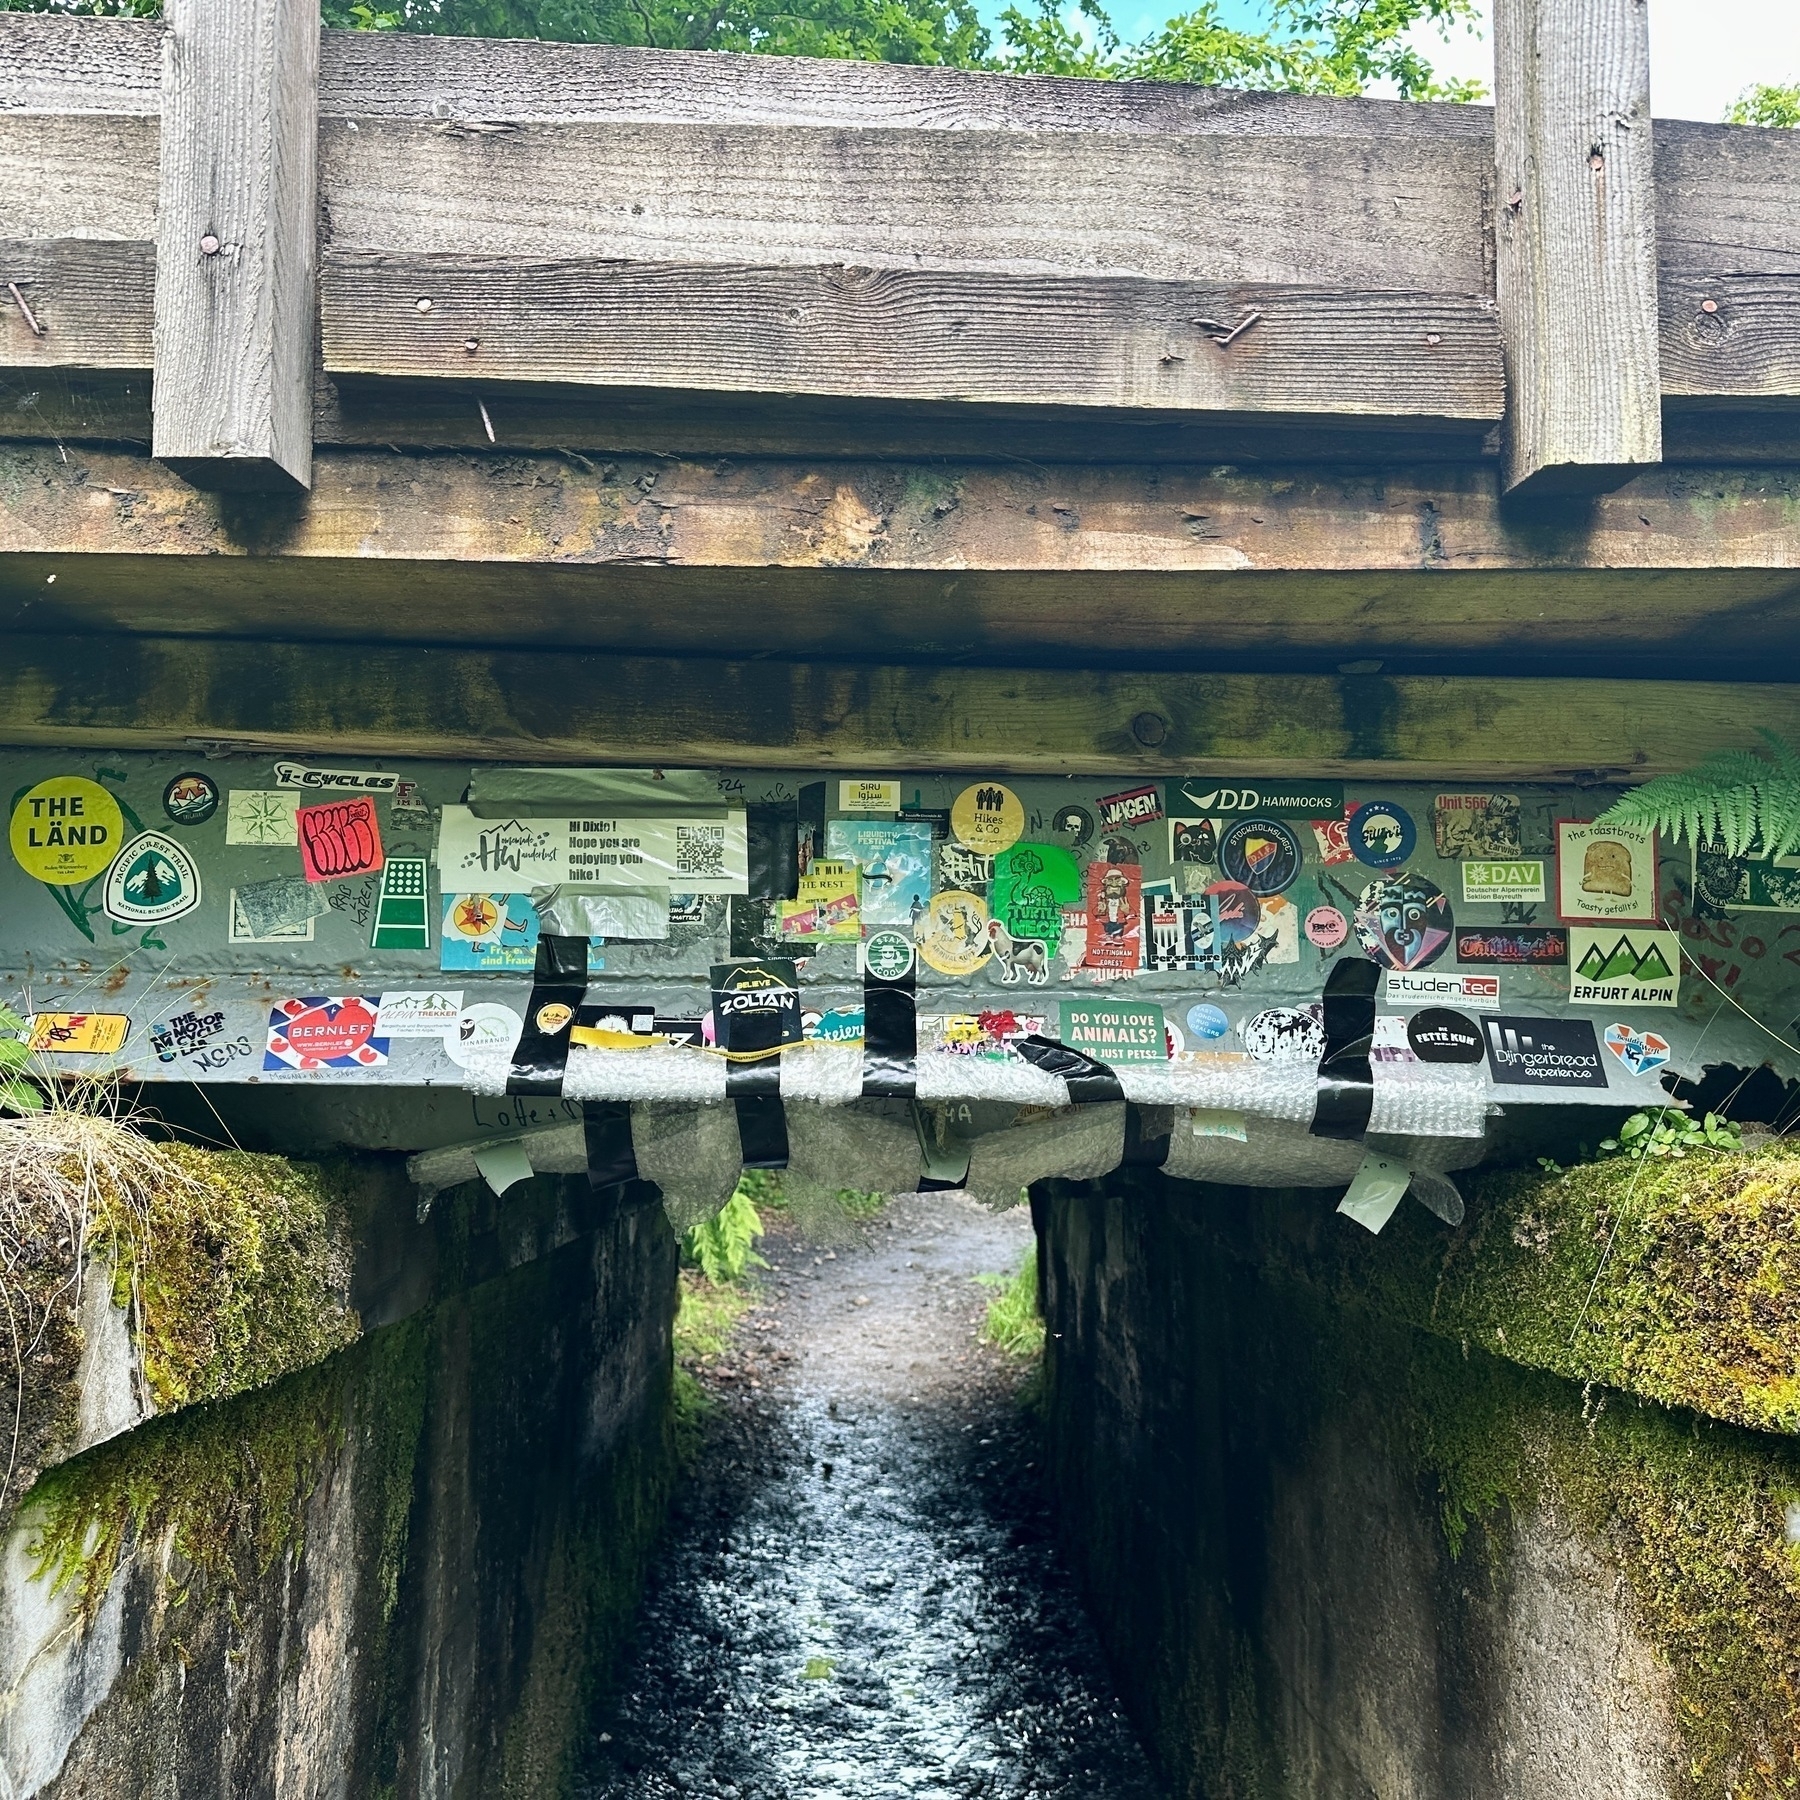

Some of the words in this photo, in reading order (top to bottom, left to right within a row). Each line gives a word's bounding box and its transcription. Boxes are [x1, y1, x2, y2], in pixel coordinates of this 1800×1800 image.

[860, 783, 880, 795] SIRU
[1217, 789, 1260, 810] DD
[1262, 796, 1332, 808] HAMMOCKS
[1439, 796, 1463, 810] Unit
[1465, 796, 1488, 810] 566
[28, 797, 84, 817] THE
[974, 813, 1003, 824] Hikes
[569, 821, 580, 832] Hi
[975, 824, 983, 833] &
[985, 824, 1000, 834] Co
[28, 821, 108, 847] LÄND
[857, 830, 898, 839] LIQUICITY
[1568, 830, 1586, 841] the
[139, 841, 171, 855] CREST
[568, 837, 597, 850] Hope
[599, 837, 620, 850] you
[621, 839, 641, 848] are
[857, 838, 898, 846] FESTIVAL
[1488, 842, 1520, 857] Earwigs
[171, 853, 189, 879] TRAIL
[568, 853, 618, 866] enjoying
[115, 850, 138, 884] PACIFIC
[568, 869, 594, 881] hike
[1491, 866, 1536, 883] DAV
[819, 881, 845, 889] REST
[170, 894, 189, 908] TRAIL
[1492, 893, 1523, 901] Bayreuth
[116, 901, 147, 914] NATIONAL
[147, 904, 171, 915] SCENIC
[1159, 900, 1206, 910] Fratelli
[1576, 898, 1603, 915] Toasty
[1010, 919, 1062, 937] NECK
[876, 936, 902, 945] STAY
[1092, 948, 1134, 957] NOTTINGHAM
[480, 955, 503, 966] sind
[877, 967, 902, 977] COOL
[736, 979, 771, 990] BELIEVE
[1388, 976, 1498, 996] studentec
[1573, 986, 1629, 1000] ERFURT
[1631, 988, 1673, 1001] ALPIN
[719, 993, 794, 1016] ZOLTAN
[169, 1011, 197, 1028] THE
[1071, 1013, 1089, 1024] DO
[1093, 1014, 1120, 1026] YOU
[1123, 1015, 1155, 1027] LOVE
[1194, 1011, 1222, 1024] LONDON
[1195, 1018, 1210, 1027] RUG
[173, 1012, 226, 1038] MOTOR
[291, 1024, 370, 1038] BERNLEF
[1190, 1023, 1220, 1037] DEALERS
[176, 1022, 224, 1046] CYCLE
[1071, 1027, 1157, 1044] ANIMALS?
[1415, 1032, 1449, 1043] FETTE
[1450, 1032, 1475, 1046] KUH
[1081, 1047, 1097, 1058] OR
[1100, 1048, 1124, 1058] JUST
[1127, 1049, 1157, 1060] PETS?
[1541, 1043, 1556, 1051] the
[1524, 1067, 1592, 1078] experience
